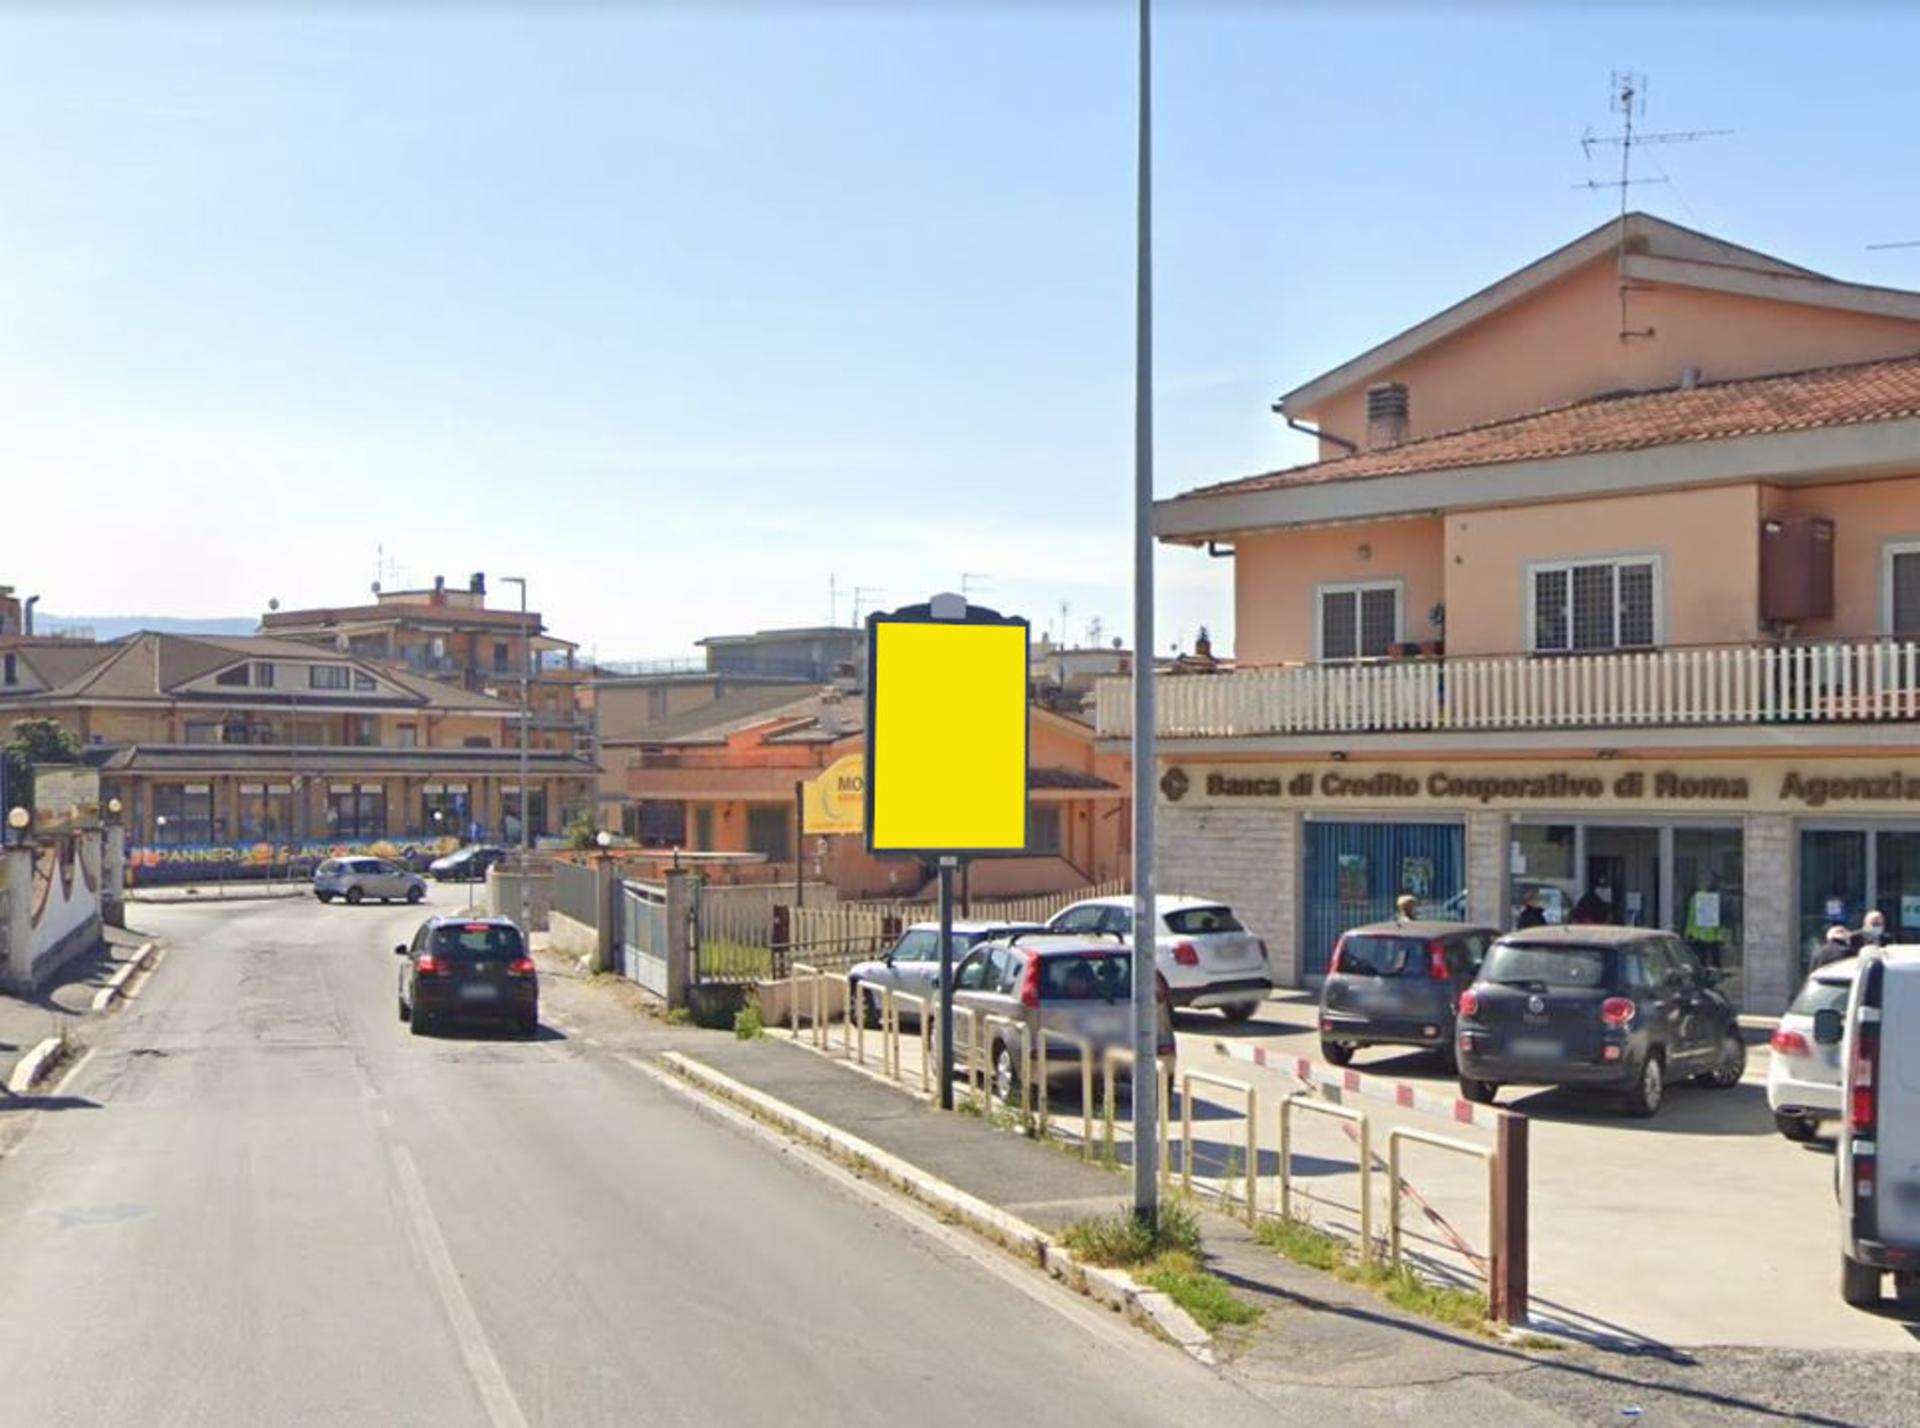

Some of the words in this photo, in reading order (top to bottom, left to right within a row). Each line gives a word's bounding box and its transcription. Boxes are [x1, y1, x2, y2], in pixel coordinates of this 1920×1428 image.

[1206, 773, 1281, 797] Banca
[1288, 772, 1313, 796] di
[1321, 772, 1419, 797] Credito
[1426, 772, 1604, 803] Cooperativo
[1613, 772, 1644, 798] di
[1654, 772, 1749, 798] Roma
